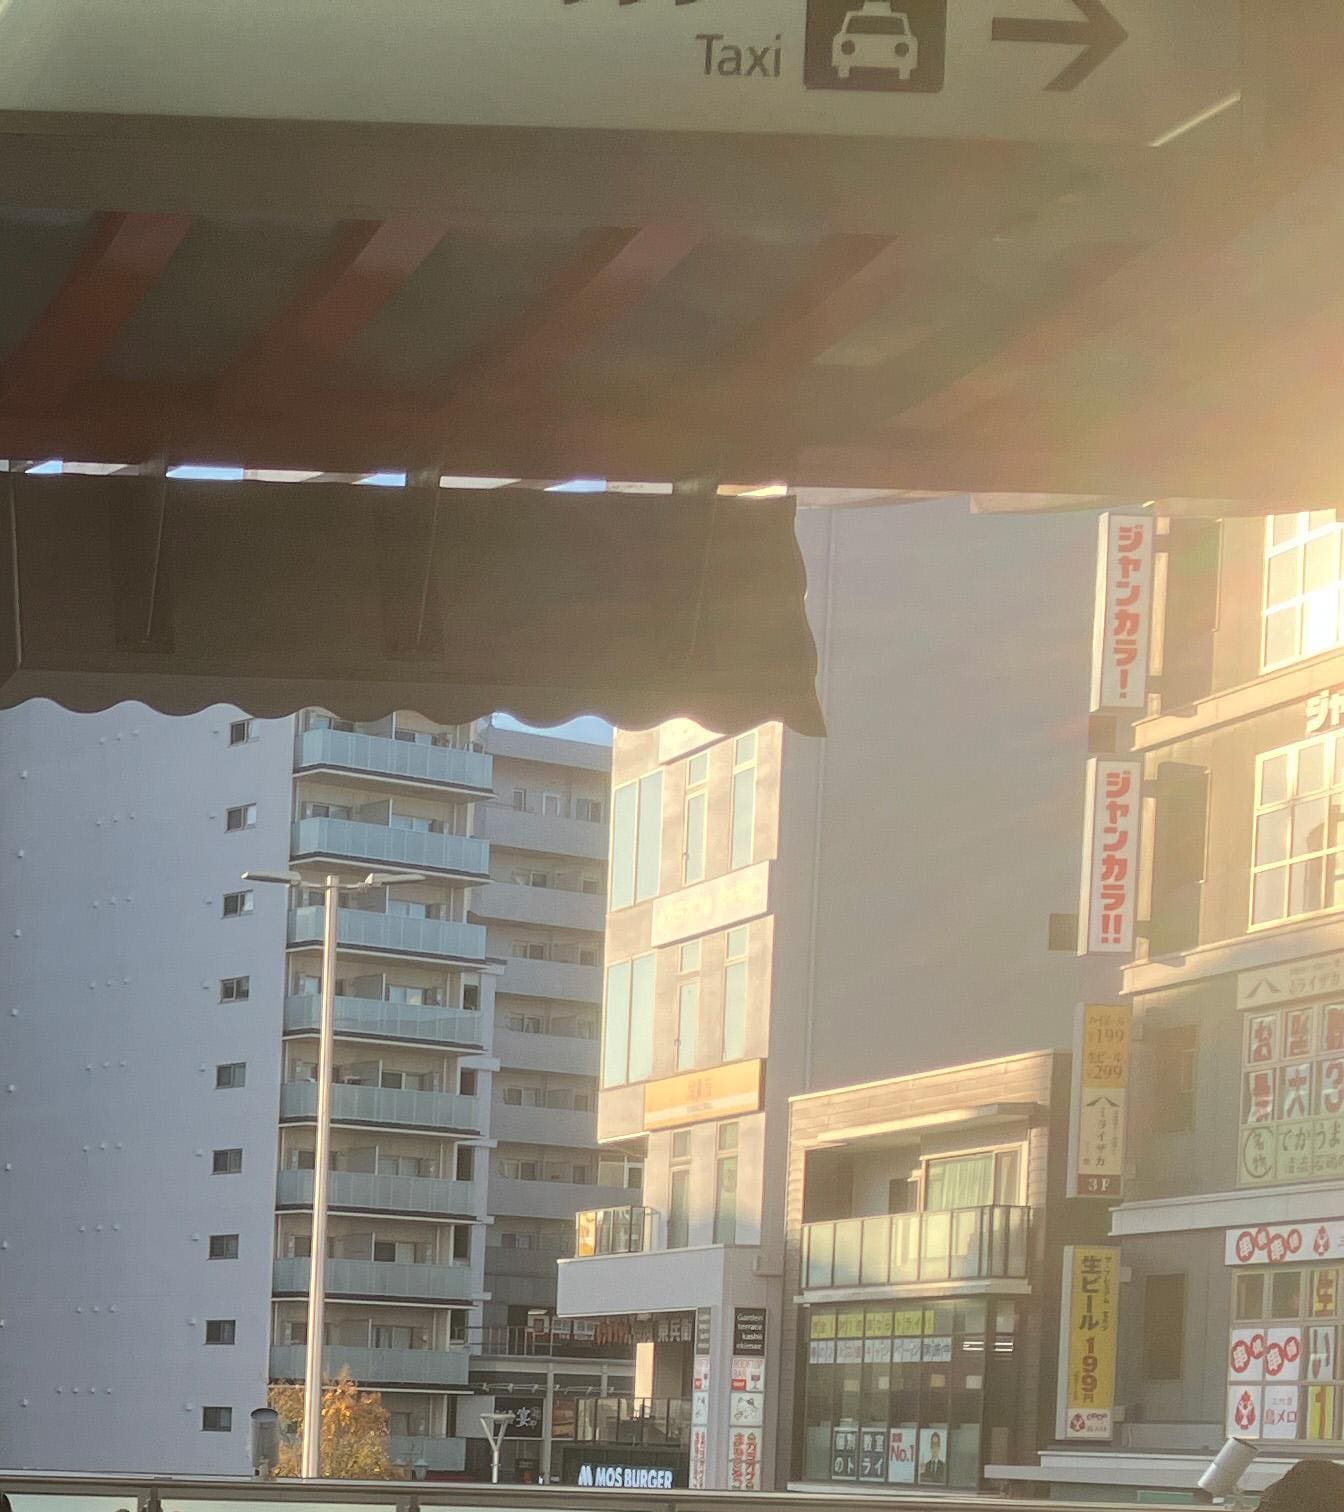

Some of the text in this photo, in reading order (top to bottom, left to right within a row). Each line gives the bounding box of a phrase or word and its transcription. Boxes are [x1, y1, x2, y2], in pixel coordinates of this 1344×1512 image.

[696, 33, 781, 77] Taxi
[1088, 1178, 1110, 1191] 3F
[1079, 1255, 1102, 1331] 生ビール
[834, 1457, 884, 1475] のトライ
[595, 1467, 673, 1488] MOS BURGER
